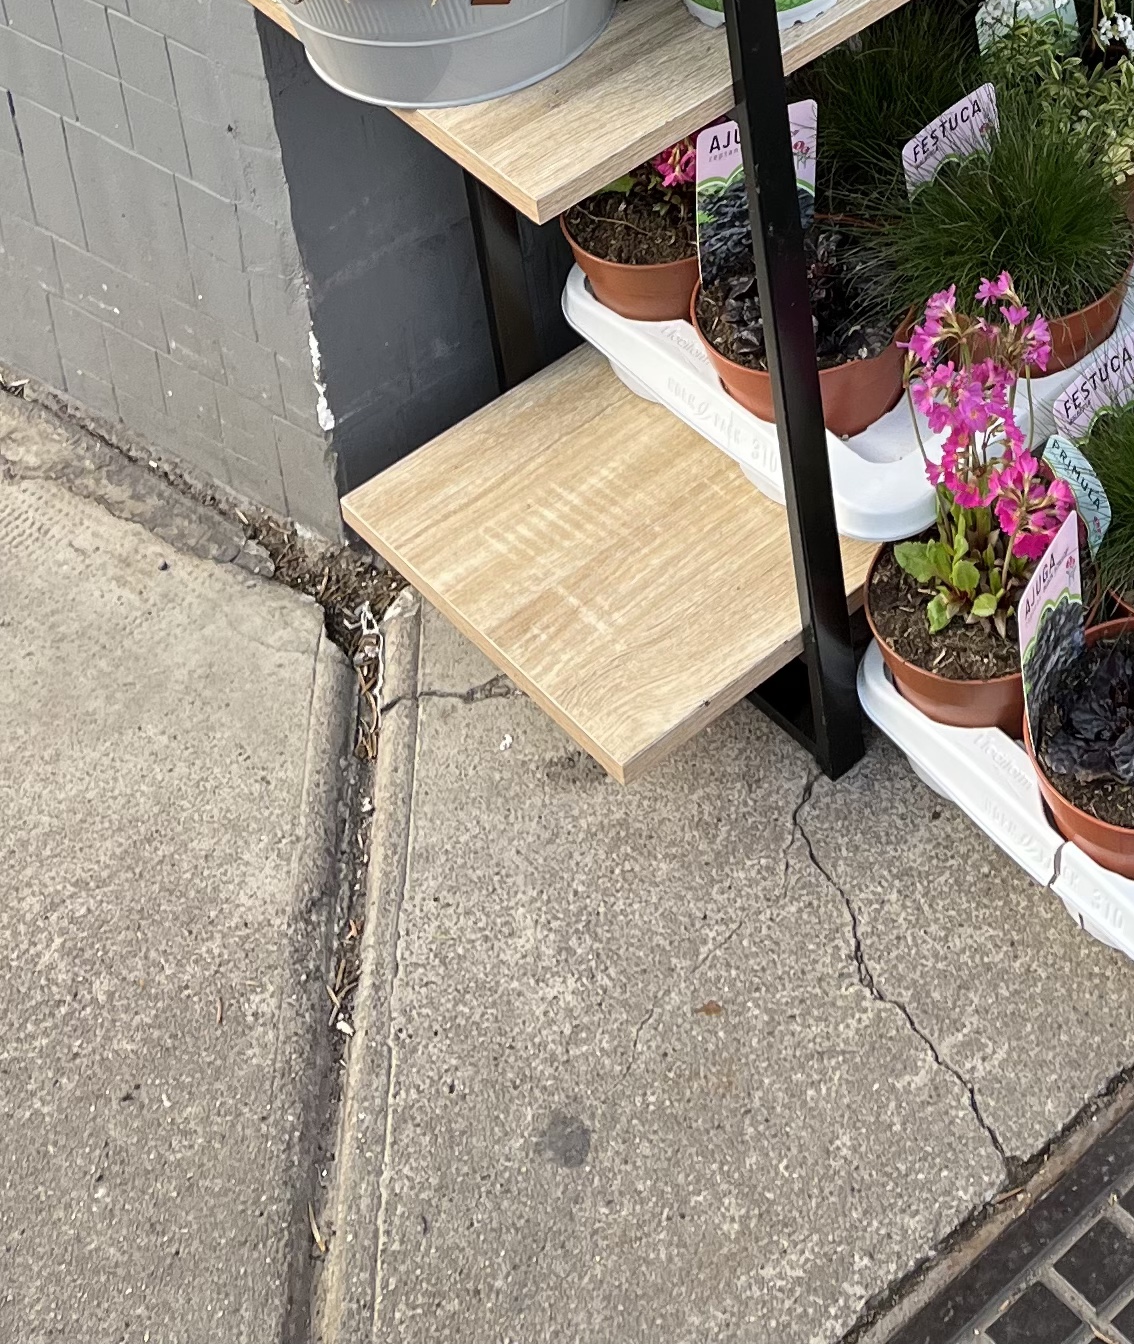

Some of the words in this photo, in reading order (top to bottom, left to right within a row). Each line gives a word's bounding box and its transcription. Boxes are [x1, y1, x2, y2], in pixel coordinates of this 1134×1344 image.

[913, 99, 982, 163] FESTUCA
[1063, 347, 1132, 419] FESTUCA
[1052, 439, 1100, 511] PRIMULA
[1025, 552, 1055, 616] AJUGA
